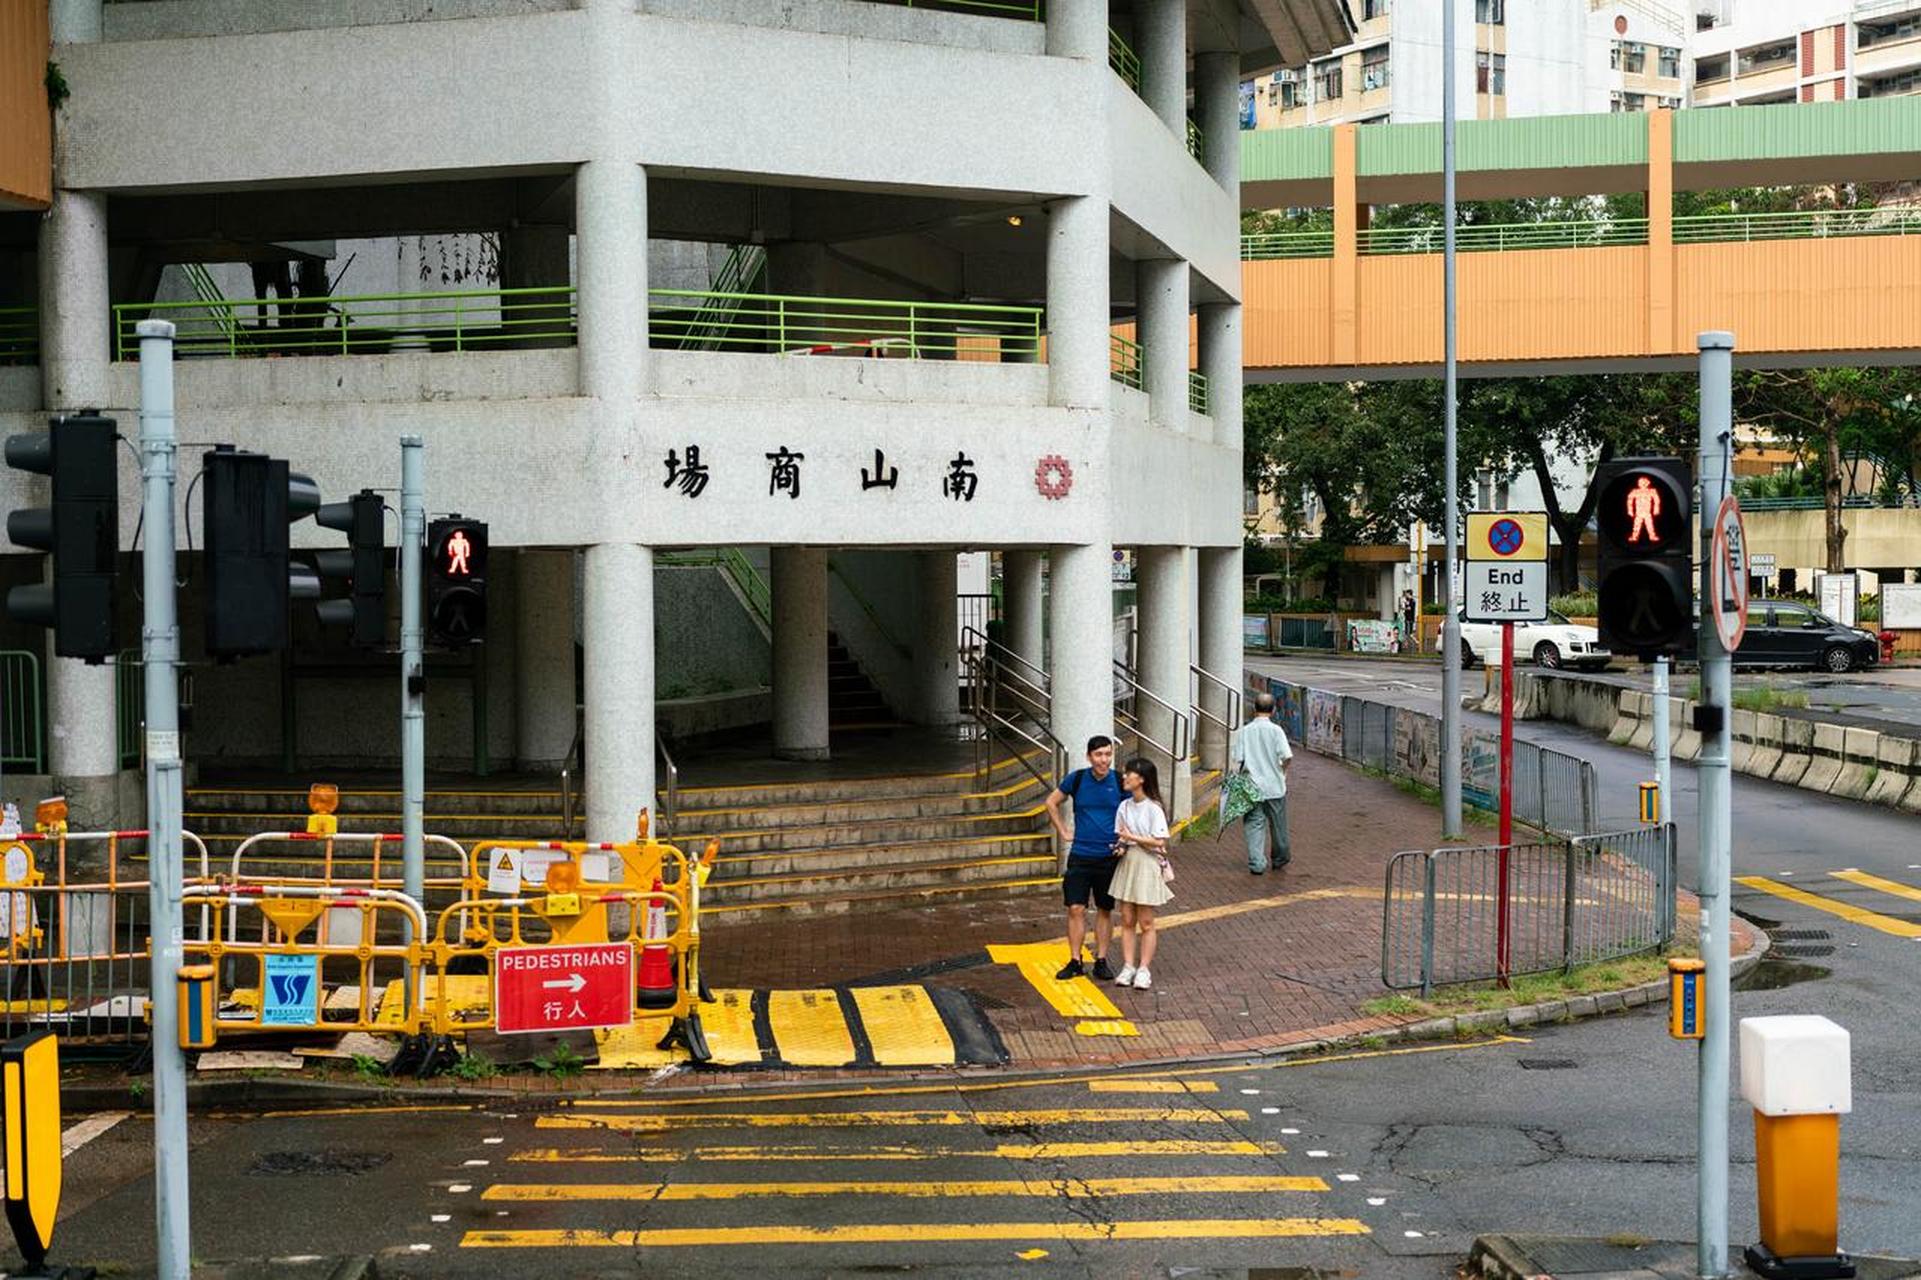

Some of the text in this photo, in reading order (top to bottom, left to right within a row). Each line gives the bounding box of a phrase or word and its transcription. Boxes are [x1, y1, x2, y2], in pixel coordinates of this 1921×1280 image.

[1488, 568, 1523, 584] End
[1481, 591, 1530, 612] 終止
[503, 950, 626, 970] PEDESTRIANS
[543, 1000, 587, 1021] 行人
